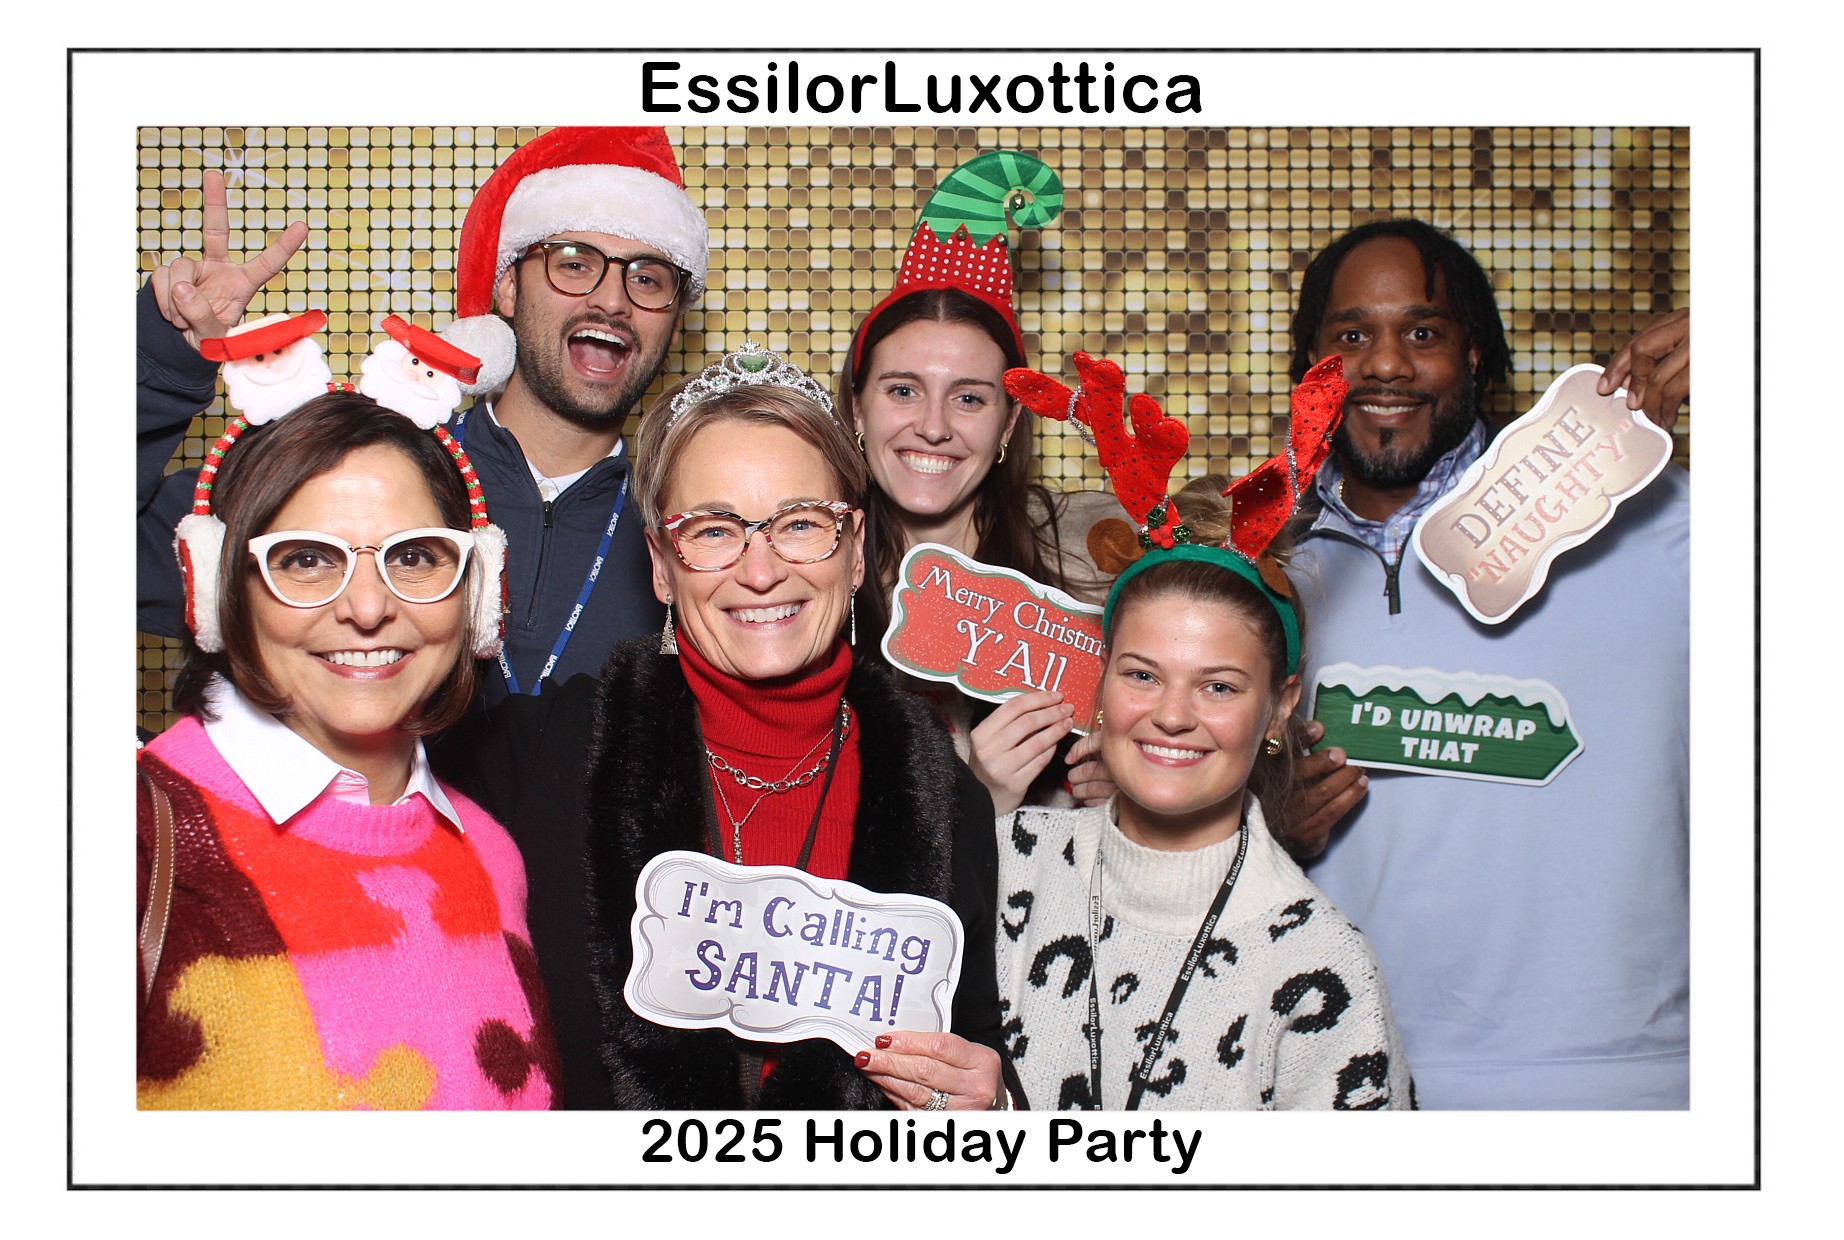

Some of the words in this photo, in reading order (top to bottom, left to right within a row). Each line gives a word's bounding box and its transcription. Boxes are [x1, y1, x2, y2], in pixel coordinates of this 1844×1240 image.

[1450, 405, 1596, 549] DEFINE
[1467, 419, 1630, 583] "NAUGHTY"
[917, 565, 1005, 624] Merry
[1012, 600, 1105, 657] Christm
[956, 619, 1068, 693] Y'All
[1351, 702, 1392, 727] I'D
[1401, 736, 1480, 763] THAT
[677, 881, 743, 929] I'm
[763, 896, 931, 975] Calling
[1181, 914, 1218, 982] EssilorLuxottica
[684, 939, 905, 1026] SANTA!
[1090, 998, 1098, 1070] EssilorLuxottica
[1139, 1012, 1174, 1081] EssilorLuxottica
